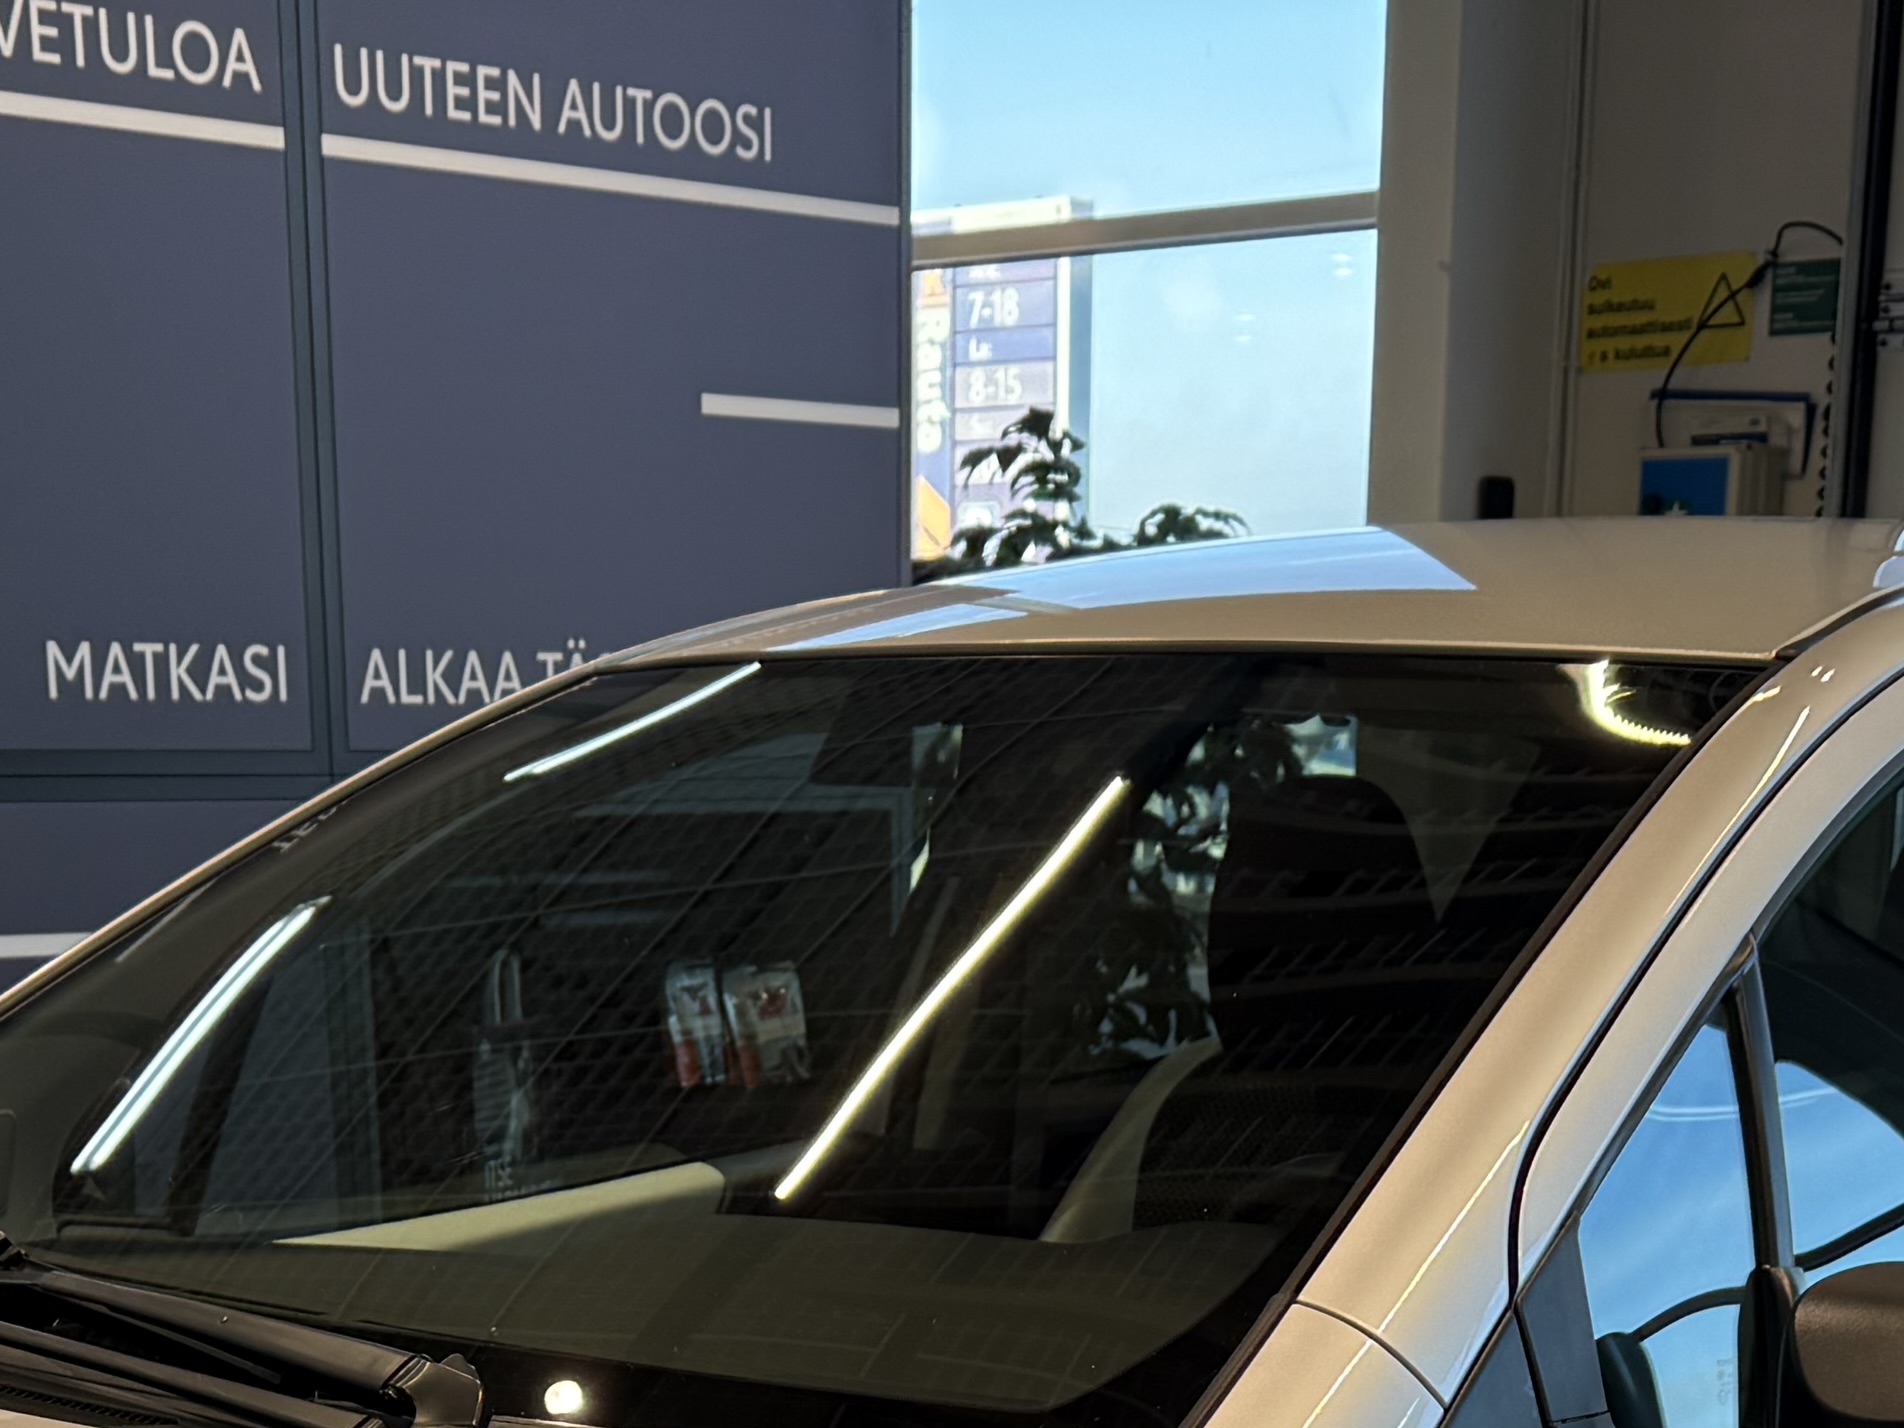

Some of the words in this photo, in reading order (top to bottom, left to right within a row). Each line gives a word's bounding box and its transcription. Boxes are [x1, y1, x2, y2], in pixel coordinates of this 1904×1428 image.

[332, 43, 542, 131] UUTEEN
[557, 77, 772, 162] AUTOOSI
[46, 640, 288, 703] MATKASI
[360, 647, 523, 704] ALKAA
